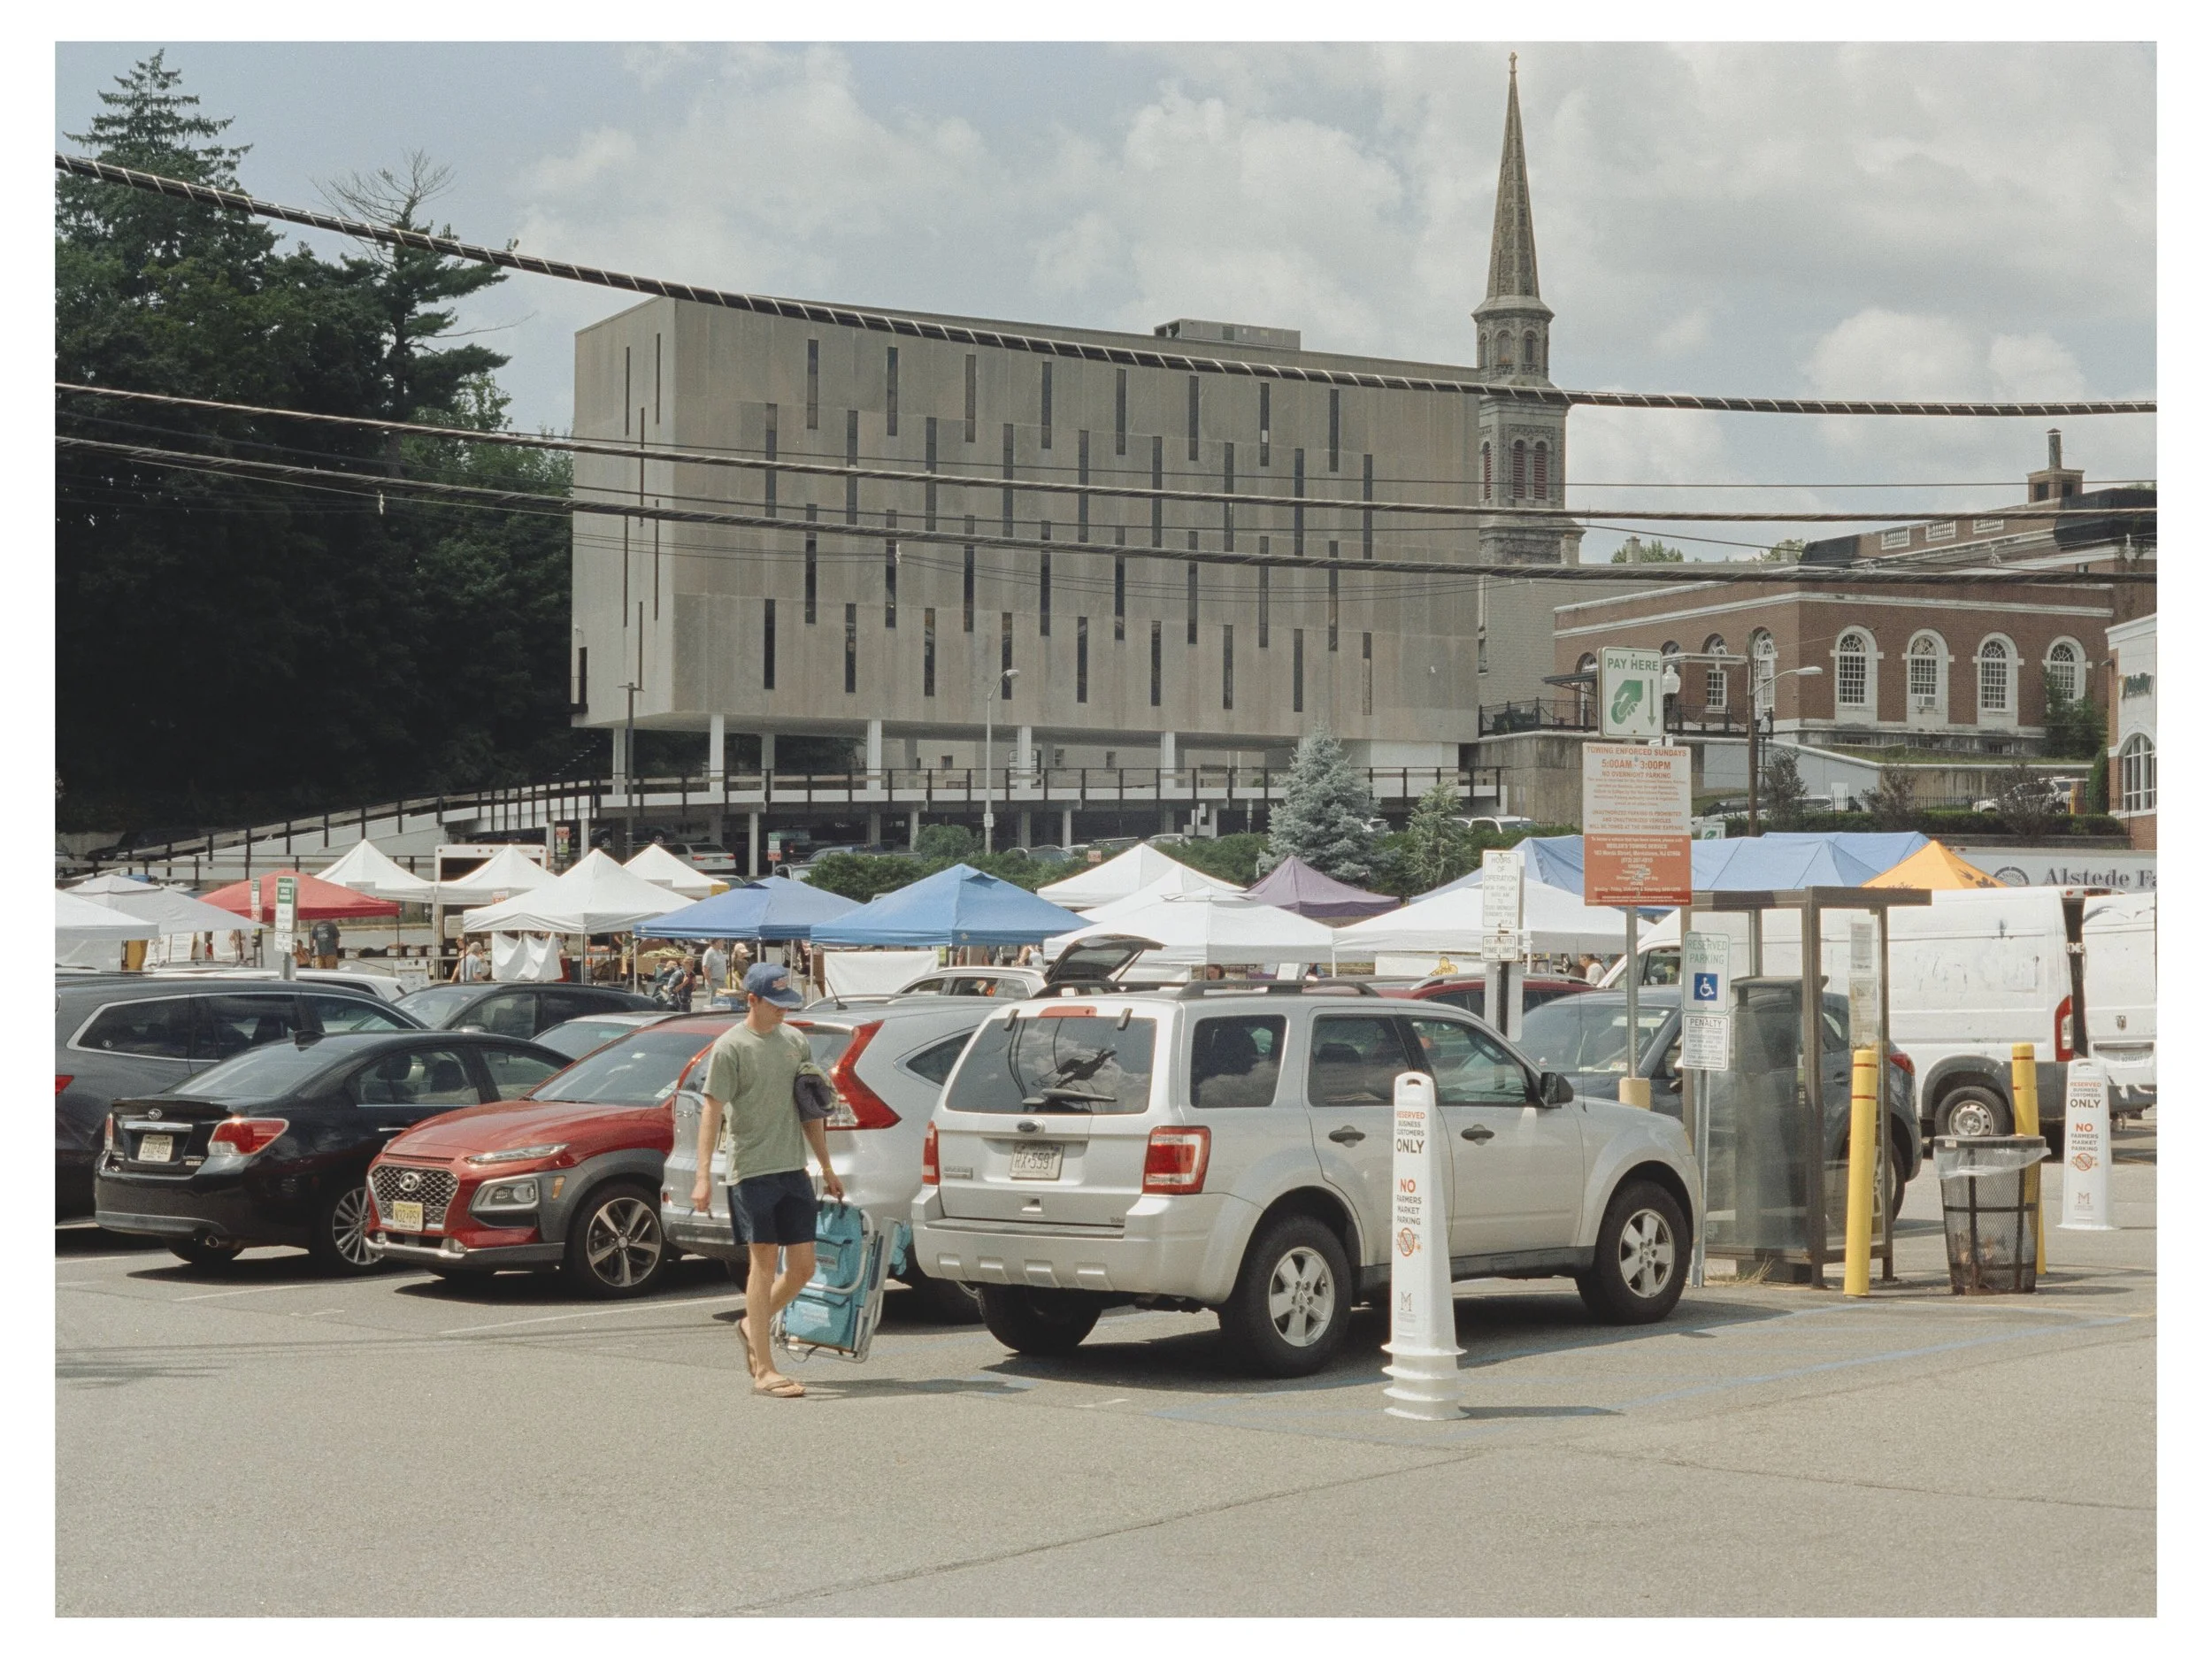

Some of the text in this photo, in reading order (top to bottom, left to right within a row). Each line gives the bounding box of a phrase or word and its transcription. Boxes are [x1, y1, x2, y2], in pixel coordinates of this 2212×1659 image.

[1607, 657, 1659, 672] PAY HERE
[1586, 746, 1614, 755] TOWING
[1616, 747, 1652, 756] ENFORCED
[1601, 758, 1632, 768] 5:00AM
[1640, 760, 1671, 770] 3:00PM
[2045, 867, 2130, 887] Alstede
[1686, 939, 1727, 951] RESERVED
[1689, 953, 1724, 965] PARKING
[1690, 1018, 1723, 1027] PENALTY
[2070, 1098, 2101, 1109] ONLY
[2075, 1123, 2093, 1133] NO
[1396, 1138, 1425, 1154] ONLY
[1400, 1178, 1417, 1194] NO
[1396, 1195, 1422, 1204] FARMERS
[1397, 1205, 1420, 1215] MARKET
[1397, 1216, 1421, 1225] PARKING
